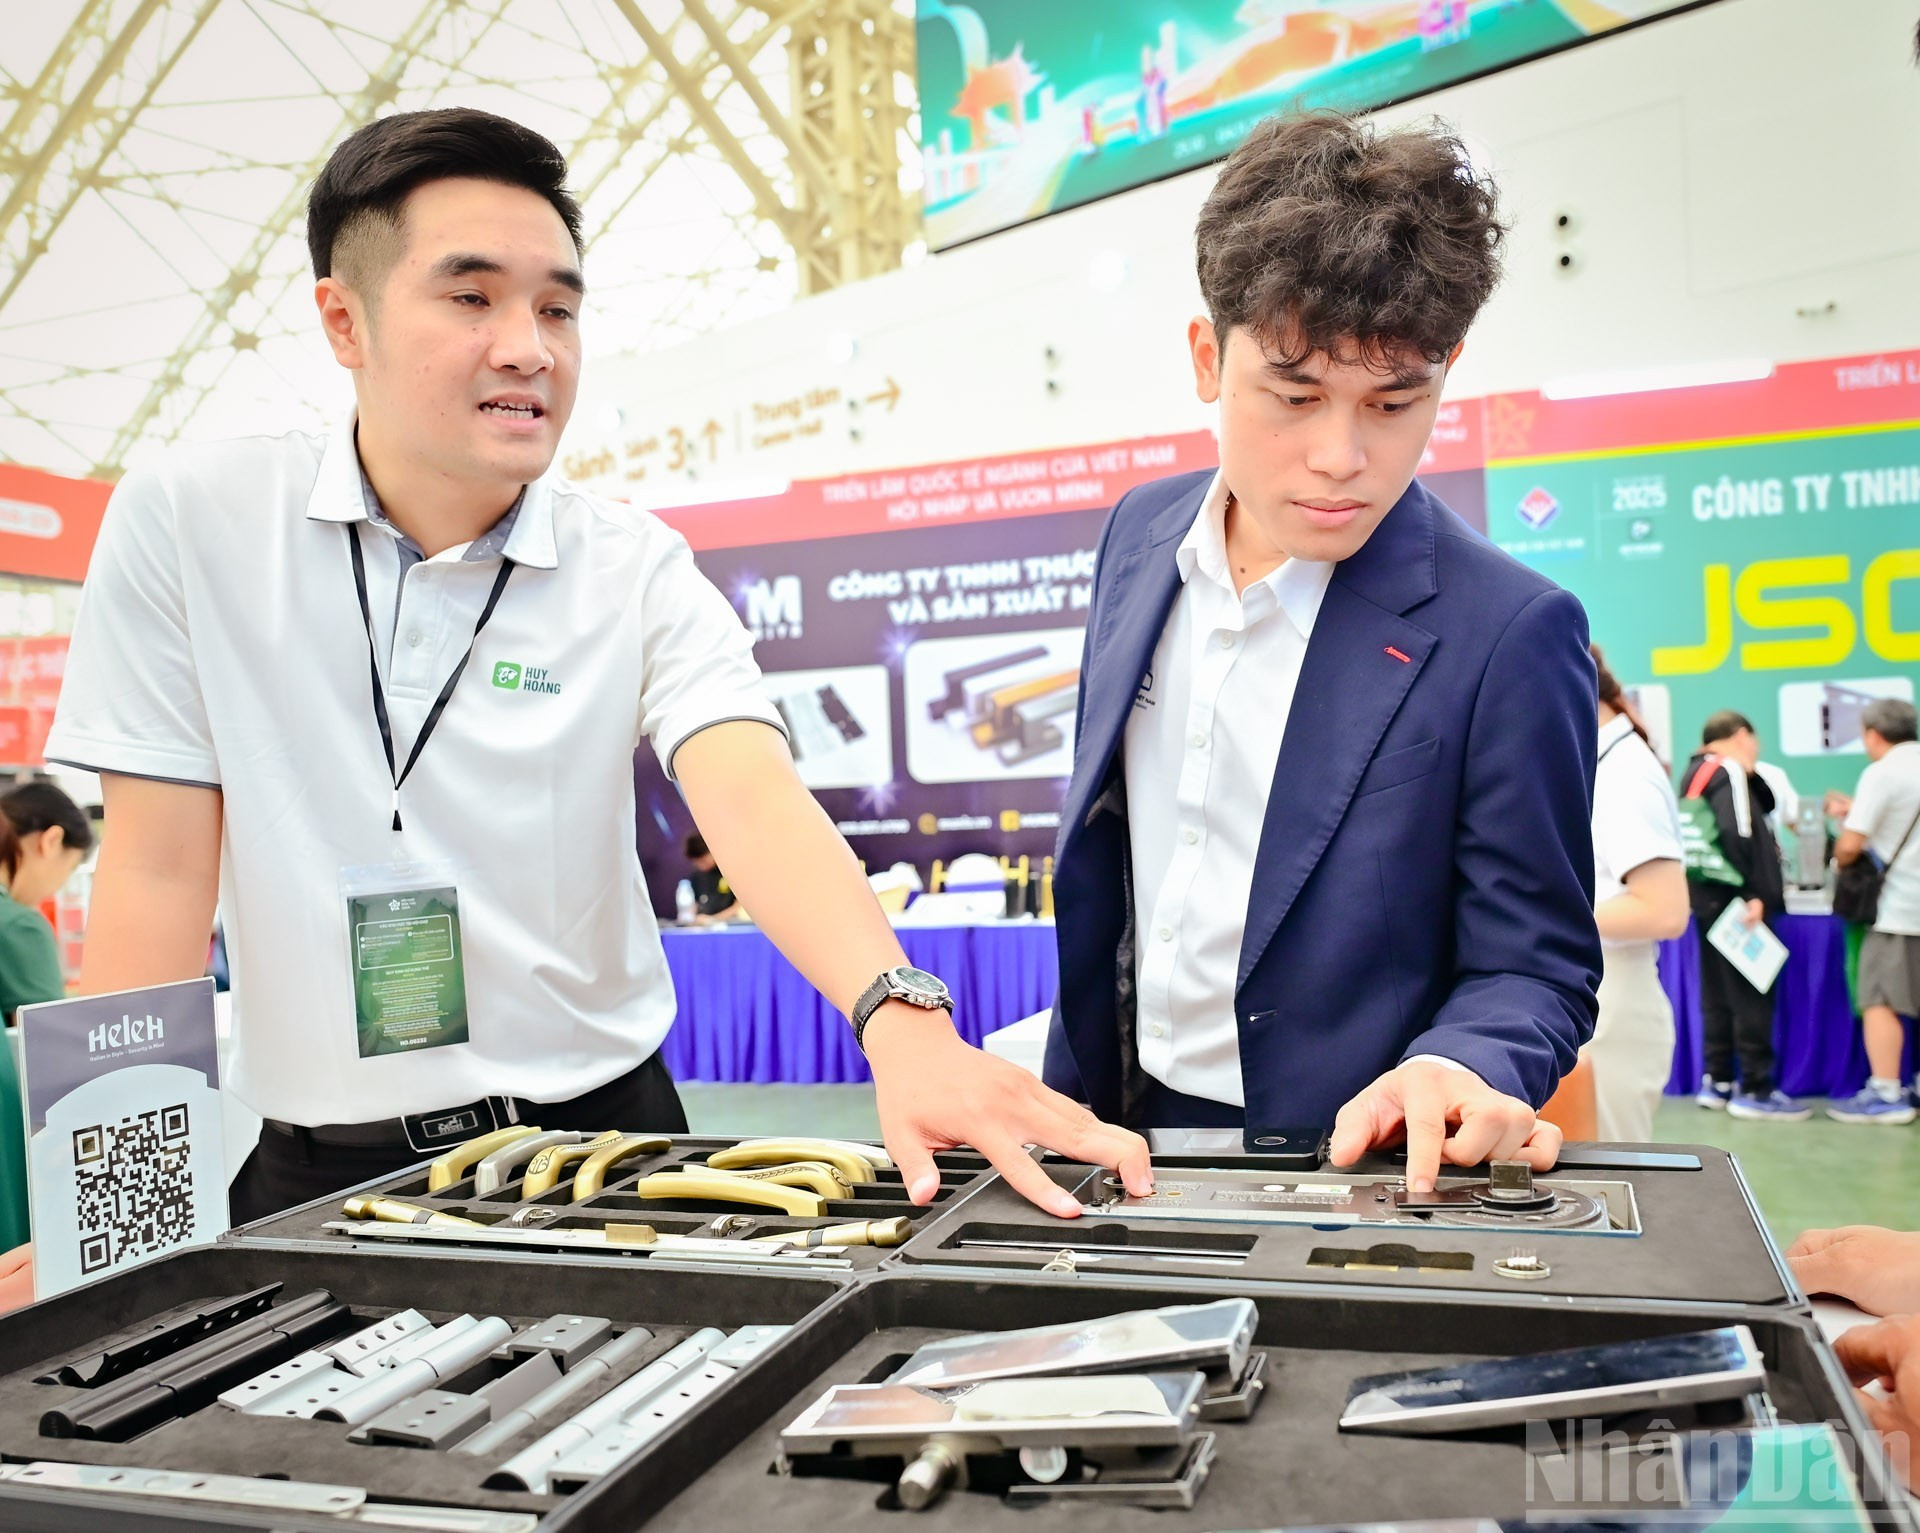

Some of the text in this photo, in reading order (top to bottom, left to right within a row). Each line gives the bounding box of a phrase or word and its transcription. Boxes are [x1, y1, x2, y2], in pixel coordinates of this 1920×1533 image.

[666, 427, 685, 471] 3
[1132, 444, 1176, 468] NAM
[1612, 483, 1667, 511] 2025
[1692, 474, 1784, 522] CÔNG
[1790, 472, 1832, 513] TY
[828, 569, 903, 601] CÔNG
[904, 566, 941, 594] TY
[942, 558, 1020, 589] TNHH
[887, 592, 930, 625] VÀ
[525, 667, 548, 680] HUY
[111, 1050, 124, 1058] Style
[128, 1046, 148, 1055] Security
